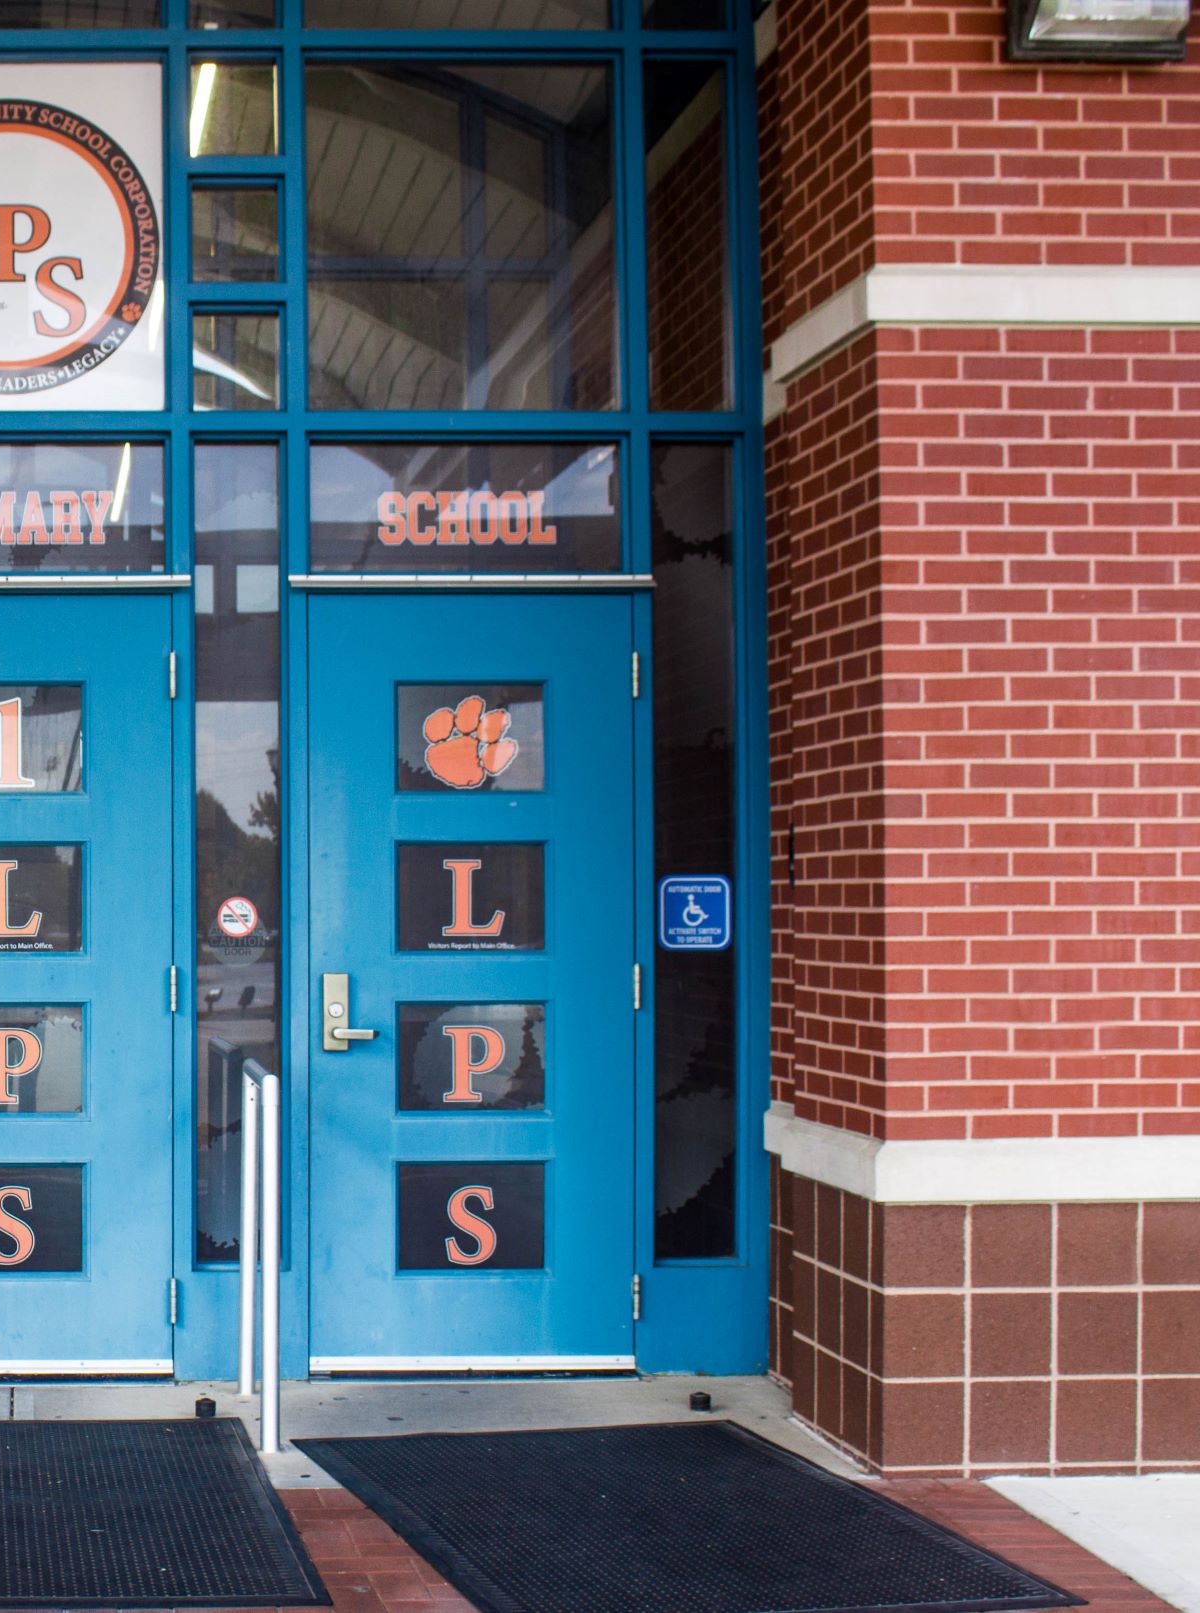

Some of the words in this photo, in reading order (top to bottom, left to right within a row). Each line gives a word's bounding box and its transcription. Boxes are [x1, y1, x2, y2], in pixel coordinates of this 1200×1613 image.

[38, 108, 113, 159] SCHOOL
[109, 155, 155, 294] CORPORATION
[64, 335, 121, 379] LEGACY
[377, 490, 557, 545] SCHOOL
[442, 859, 505, 937] L
[451, 942, 472, 950] Report
[443, 1025, 505, 1102] P
[445, 1185, 497, 1265] S
